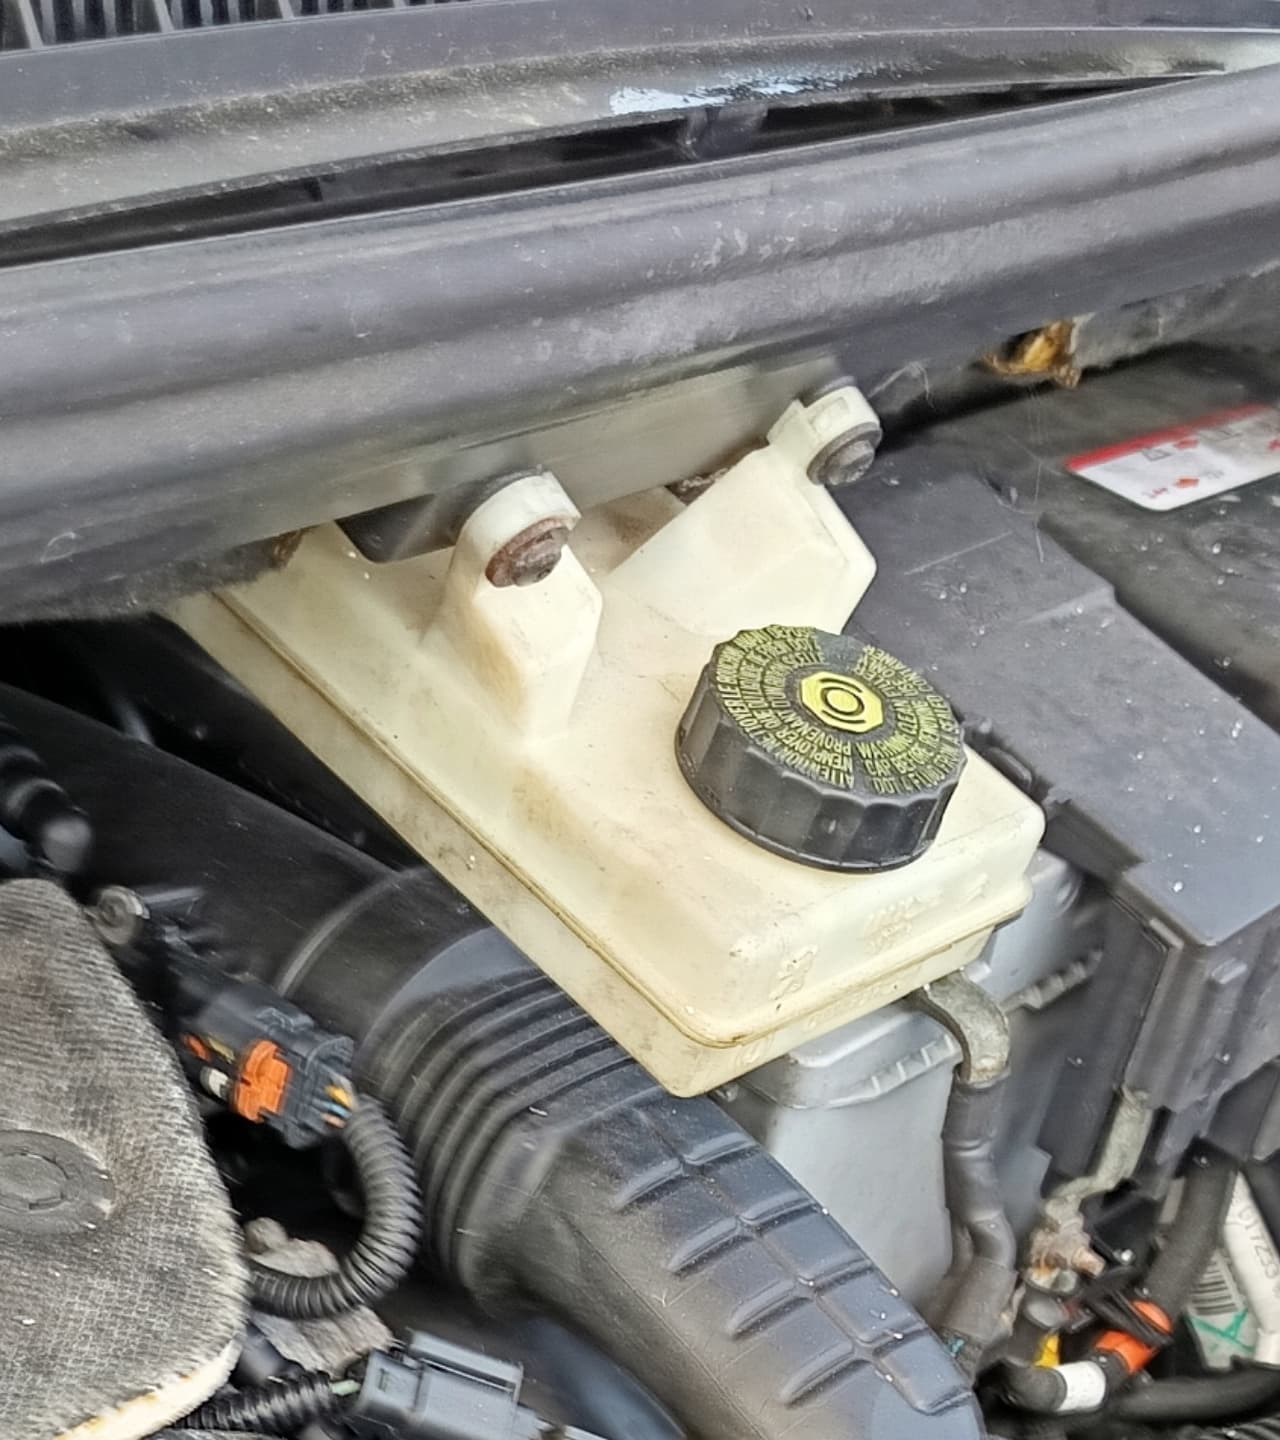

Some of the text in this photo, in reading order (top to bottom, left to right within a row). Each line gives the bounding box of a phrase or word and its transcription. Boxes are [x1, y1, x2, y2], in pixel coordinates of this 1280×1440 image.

[853, 662, 902, 697] FILLER
[862, 645, 932, 692] CONTAINER
[776, 710, 851, 754] PROVENANT
[894, 701, 917, 734] CLEAN
[864, 759, 891, 775] CAP
